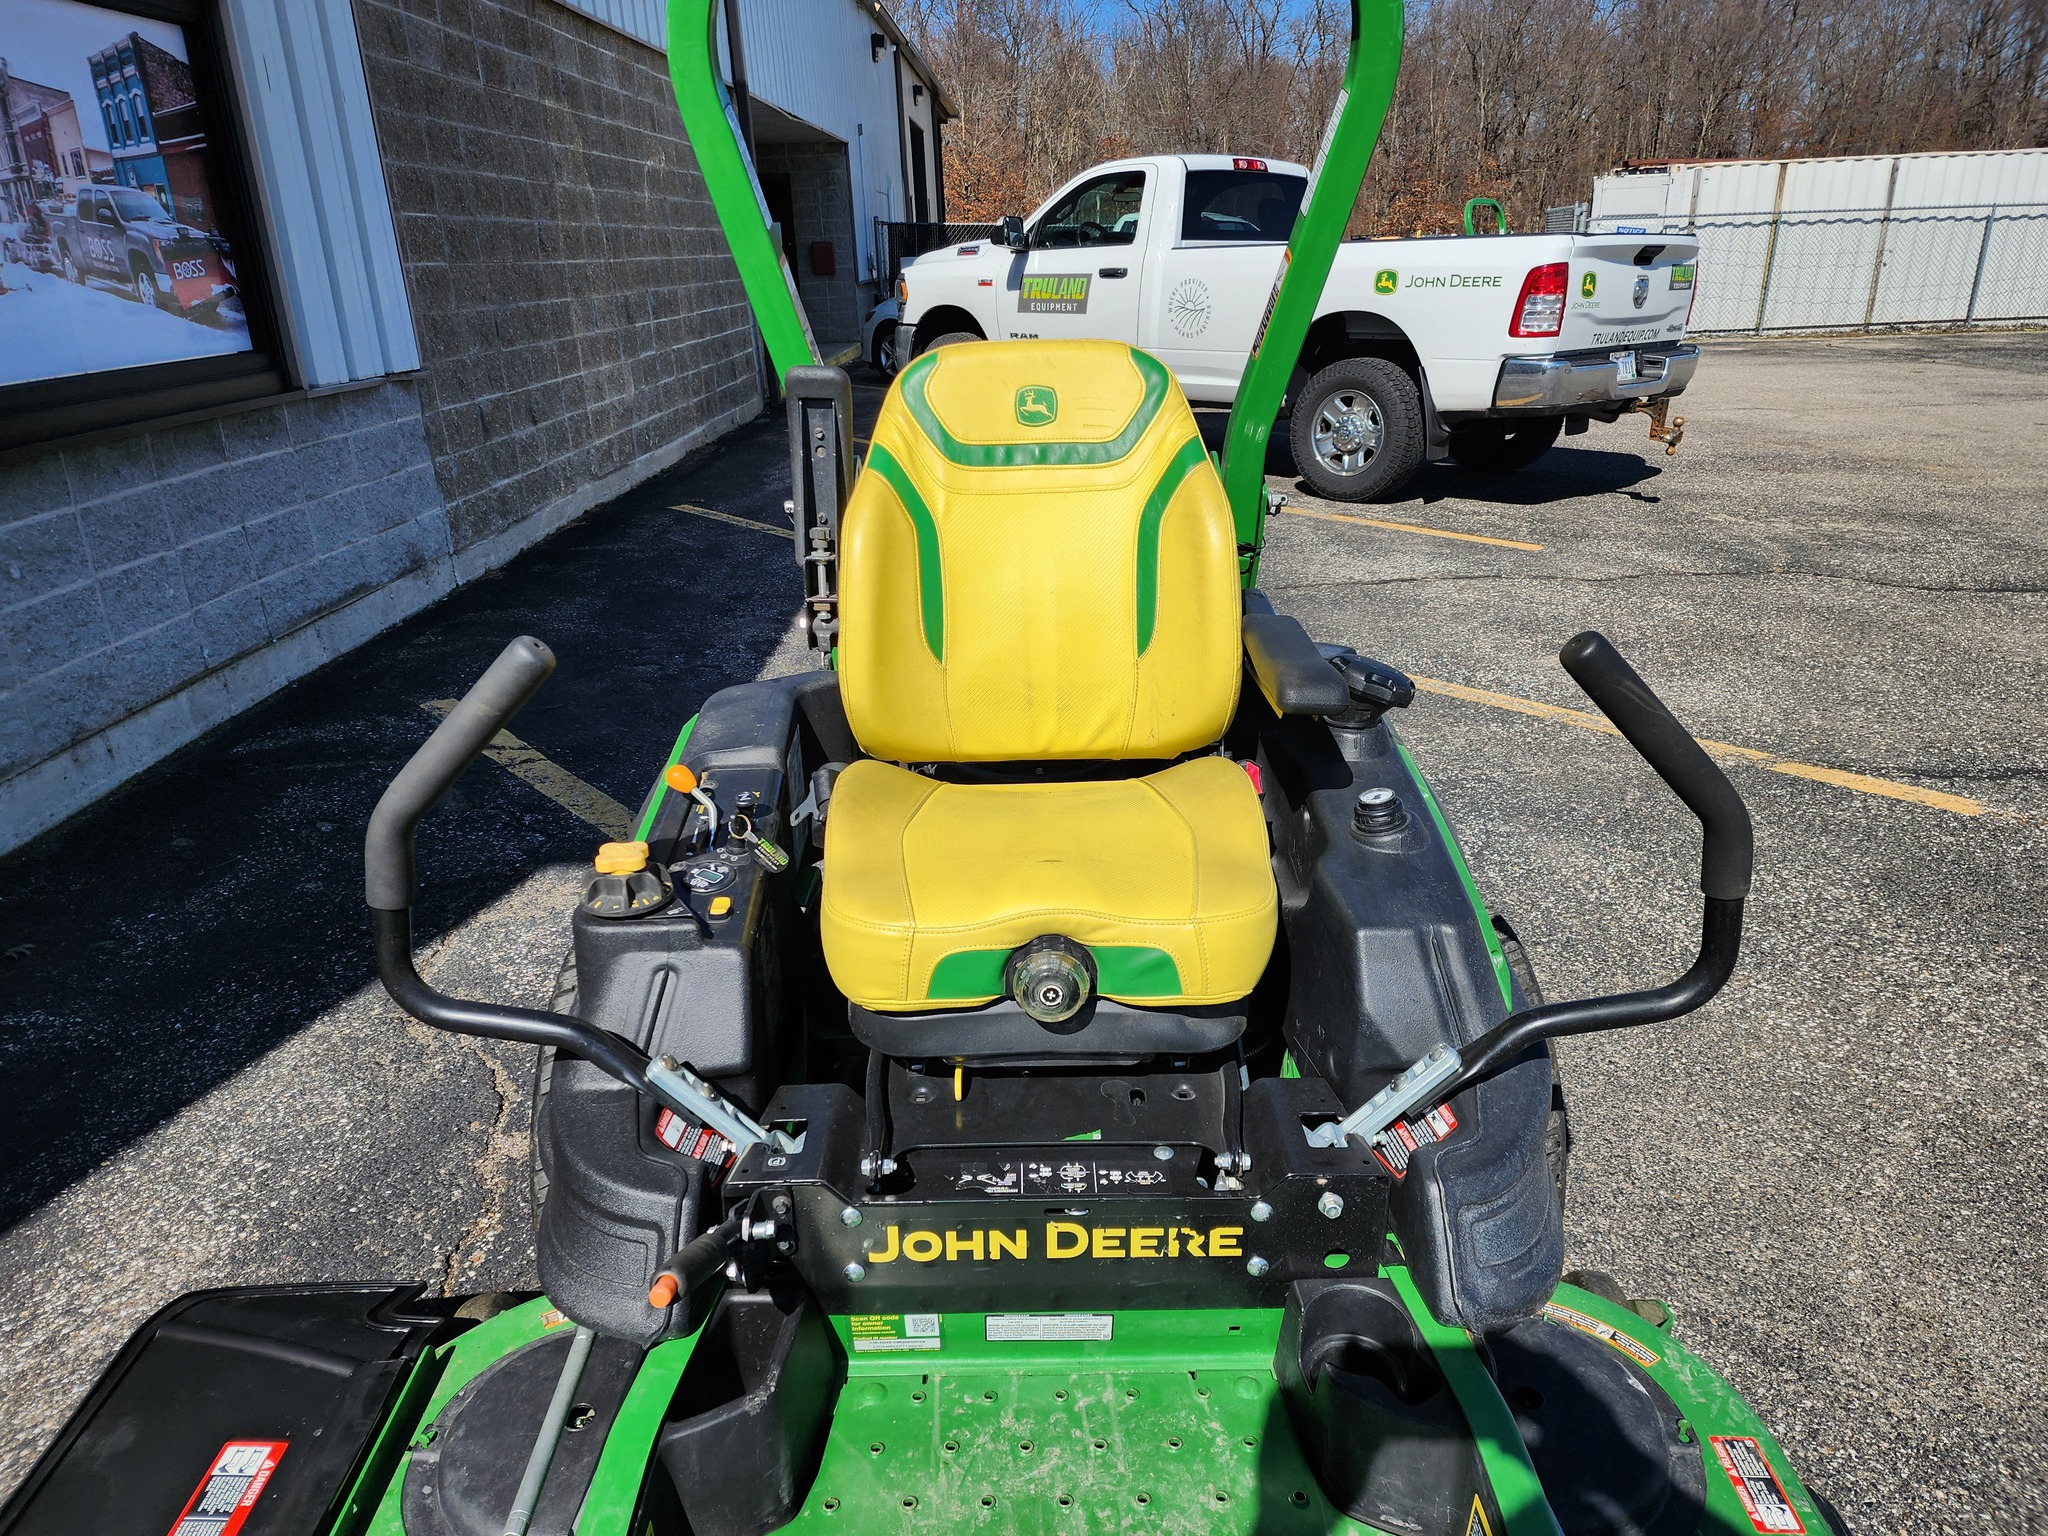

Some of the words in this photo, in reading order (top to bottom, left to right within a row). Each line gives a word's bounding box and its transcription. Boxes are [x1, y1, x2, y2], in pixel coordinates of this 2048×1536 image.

[87, 236, 115, 262] BOSS
[173, 258, 206, 281] BOSS
[1405, 274, 1447, 288] JOHN
[1450, 274, 1502, 287] DEERE
[1023, 277, 1088, 300] TRULAND
[1168, 287, 1179, 314] WHERE
[1180, 278, 1208, 293] PROVIDER
[1031, 302, 1078, 312] EQUIPMENT
[1571, 302, 1584, 310] JOHN
[1174, 326, 1194, 338] MEANS
[1196, 304, 1211, 336] PARTNER
[1591, 328, 1660, 346] TRULANDEQUIP.COM
[758, 838, 788, 866] TRULAND
[868, 1225, 1028, 1263] JOHN
[1046, 1222, 1244, 1259] DEERE
[1713, 1442, 1733, 1468] PELIGRO
[239, 1470, 270, 1506] DANGER
[1735, 1484, 1755, 1511] DANGER
